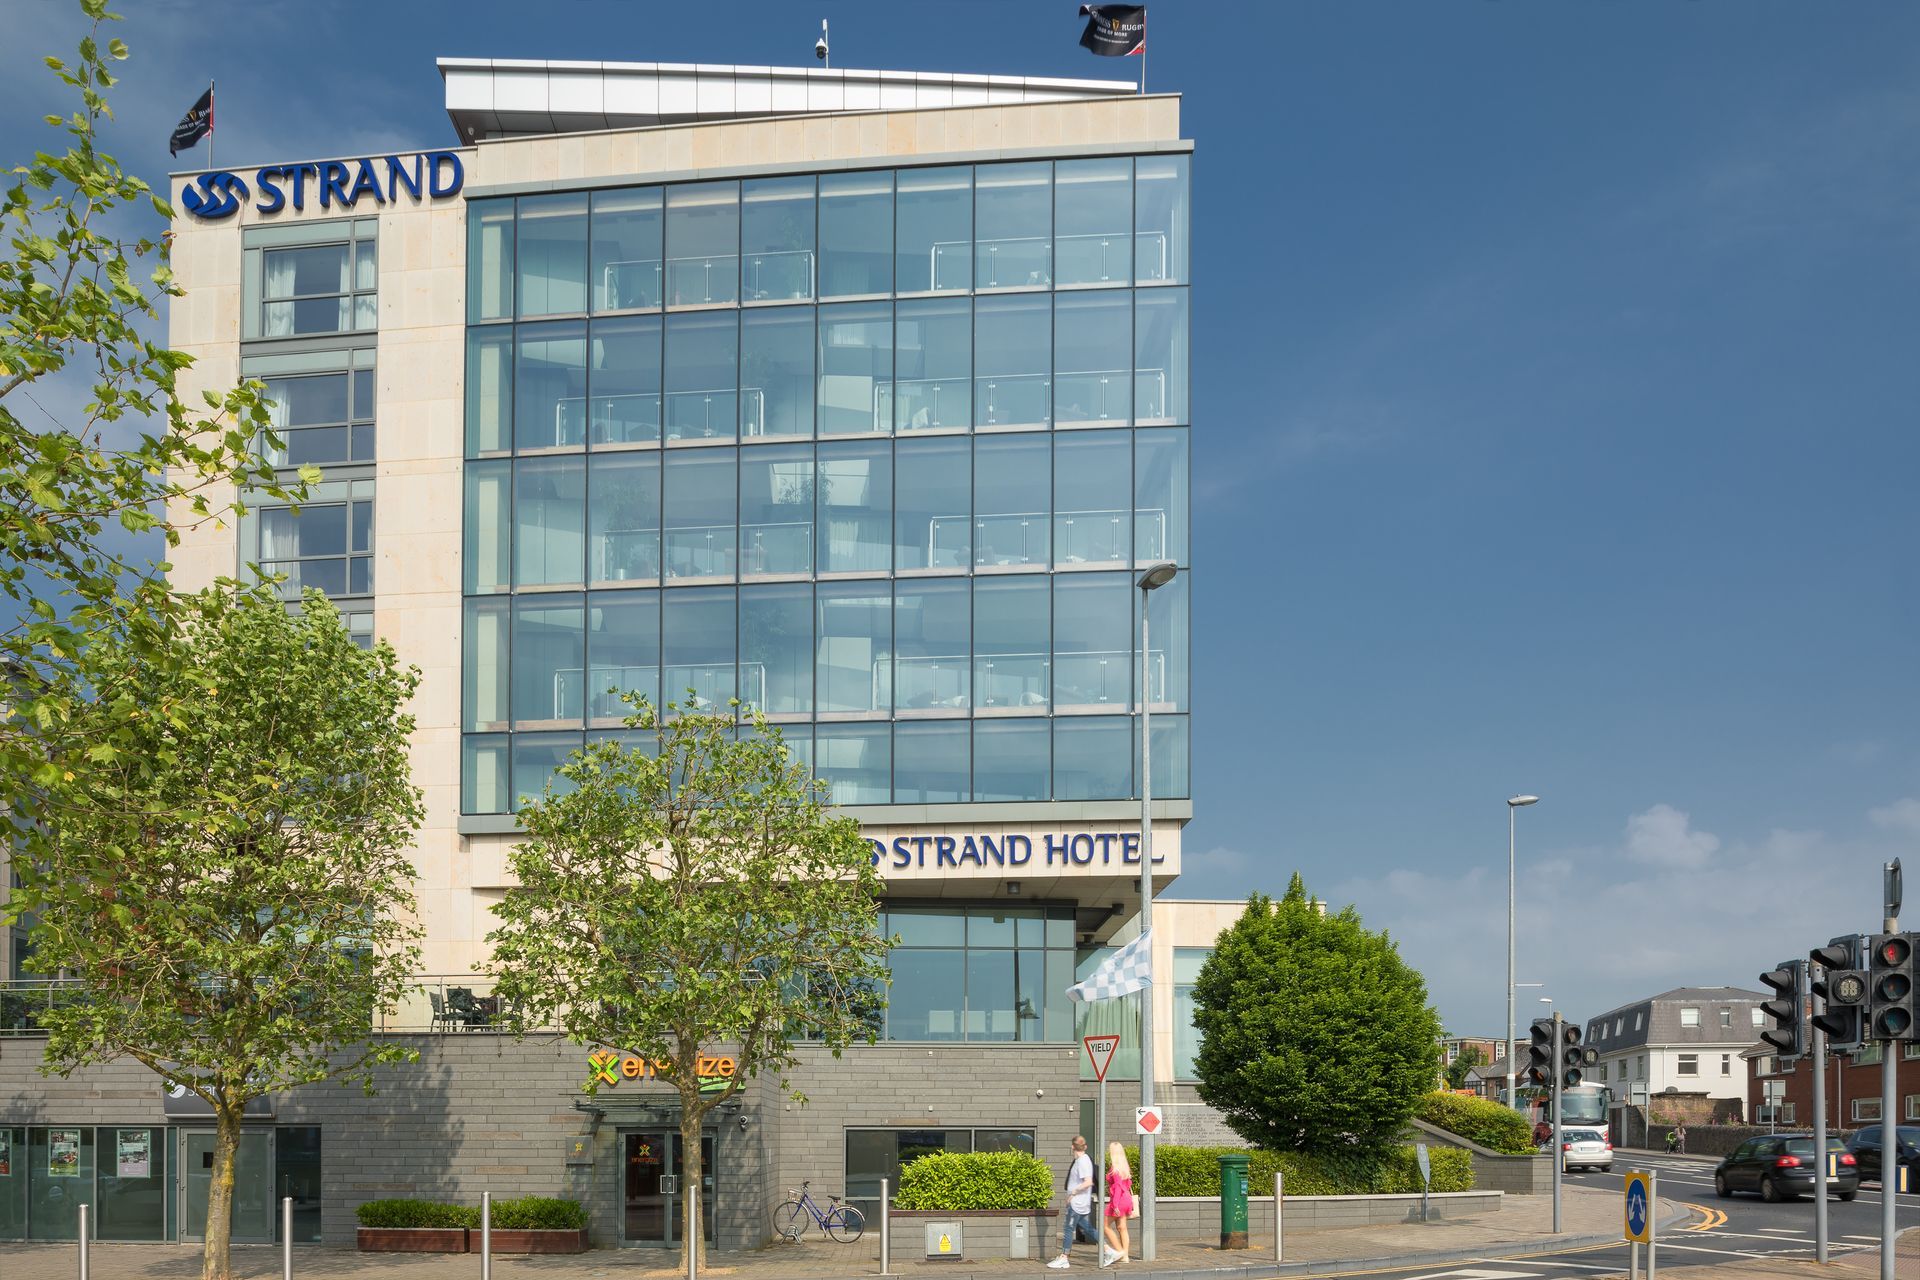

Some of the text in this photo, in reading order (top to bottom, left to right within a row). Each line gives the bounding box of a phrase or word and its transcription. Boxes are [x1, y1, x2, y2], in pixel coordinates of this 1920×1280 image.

[256, 151, 464, 214] STRAND
[892, 832, 1165, 867] STRAND HOTEL
[1090, 1042, 1112, 1053] YIELD
[622, 1051, 735, 1077] enize
